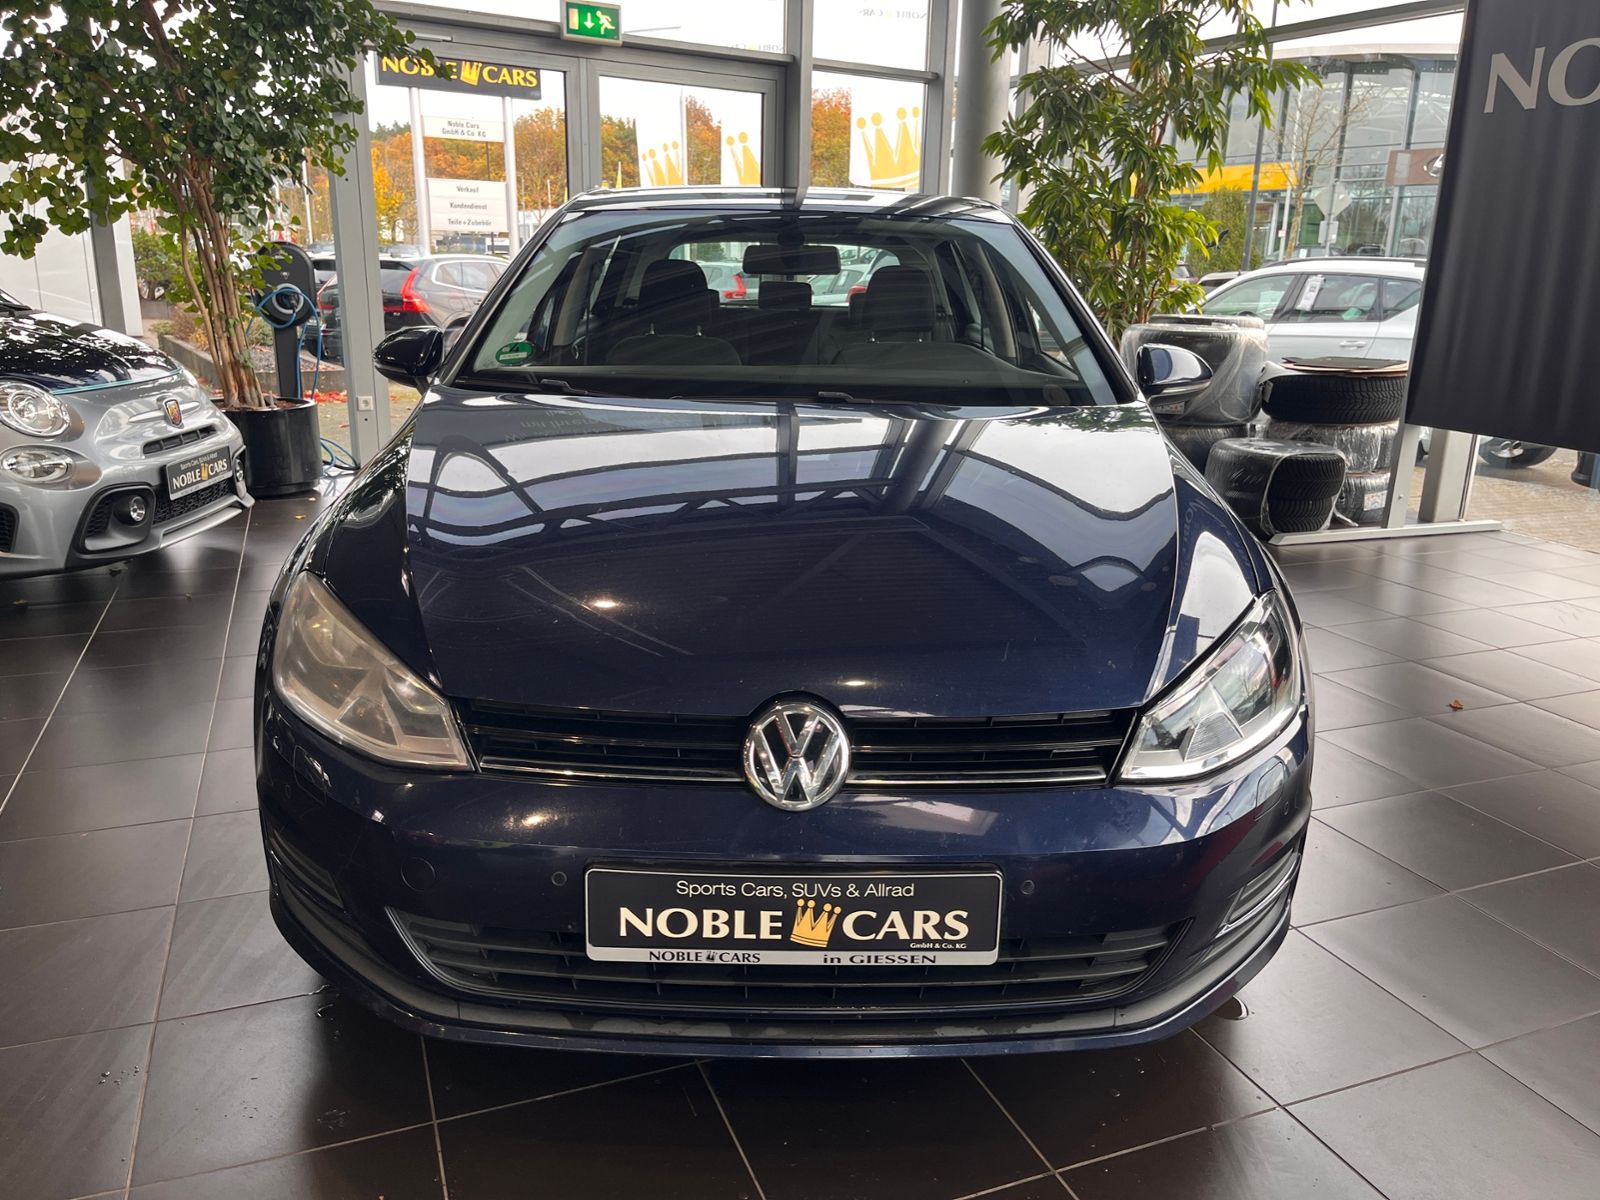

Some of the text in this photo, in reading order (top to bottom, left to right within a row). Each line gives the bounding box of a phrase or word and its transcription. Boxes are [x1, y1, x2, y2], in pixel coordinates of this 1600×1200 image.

[382, 56, 538, 88] NOBE CARS
[1483, 37, 1600, 114] NO
[172, 468, 201, 490] NOBLE
[208, 458, 228, 476] CARS
[676, 880, 915, 899] Sports Cars, SUVs & Allrad
[619, 907, 969, 940] NOBLE CARS
[649, 951, 936, 964] NOBLE CARS in GIESSEN
